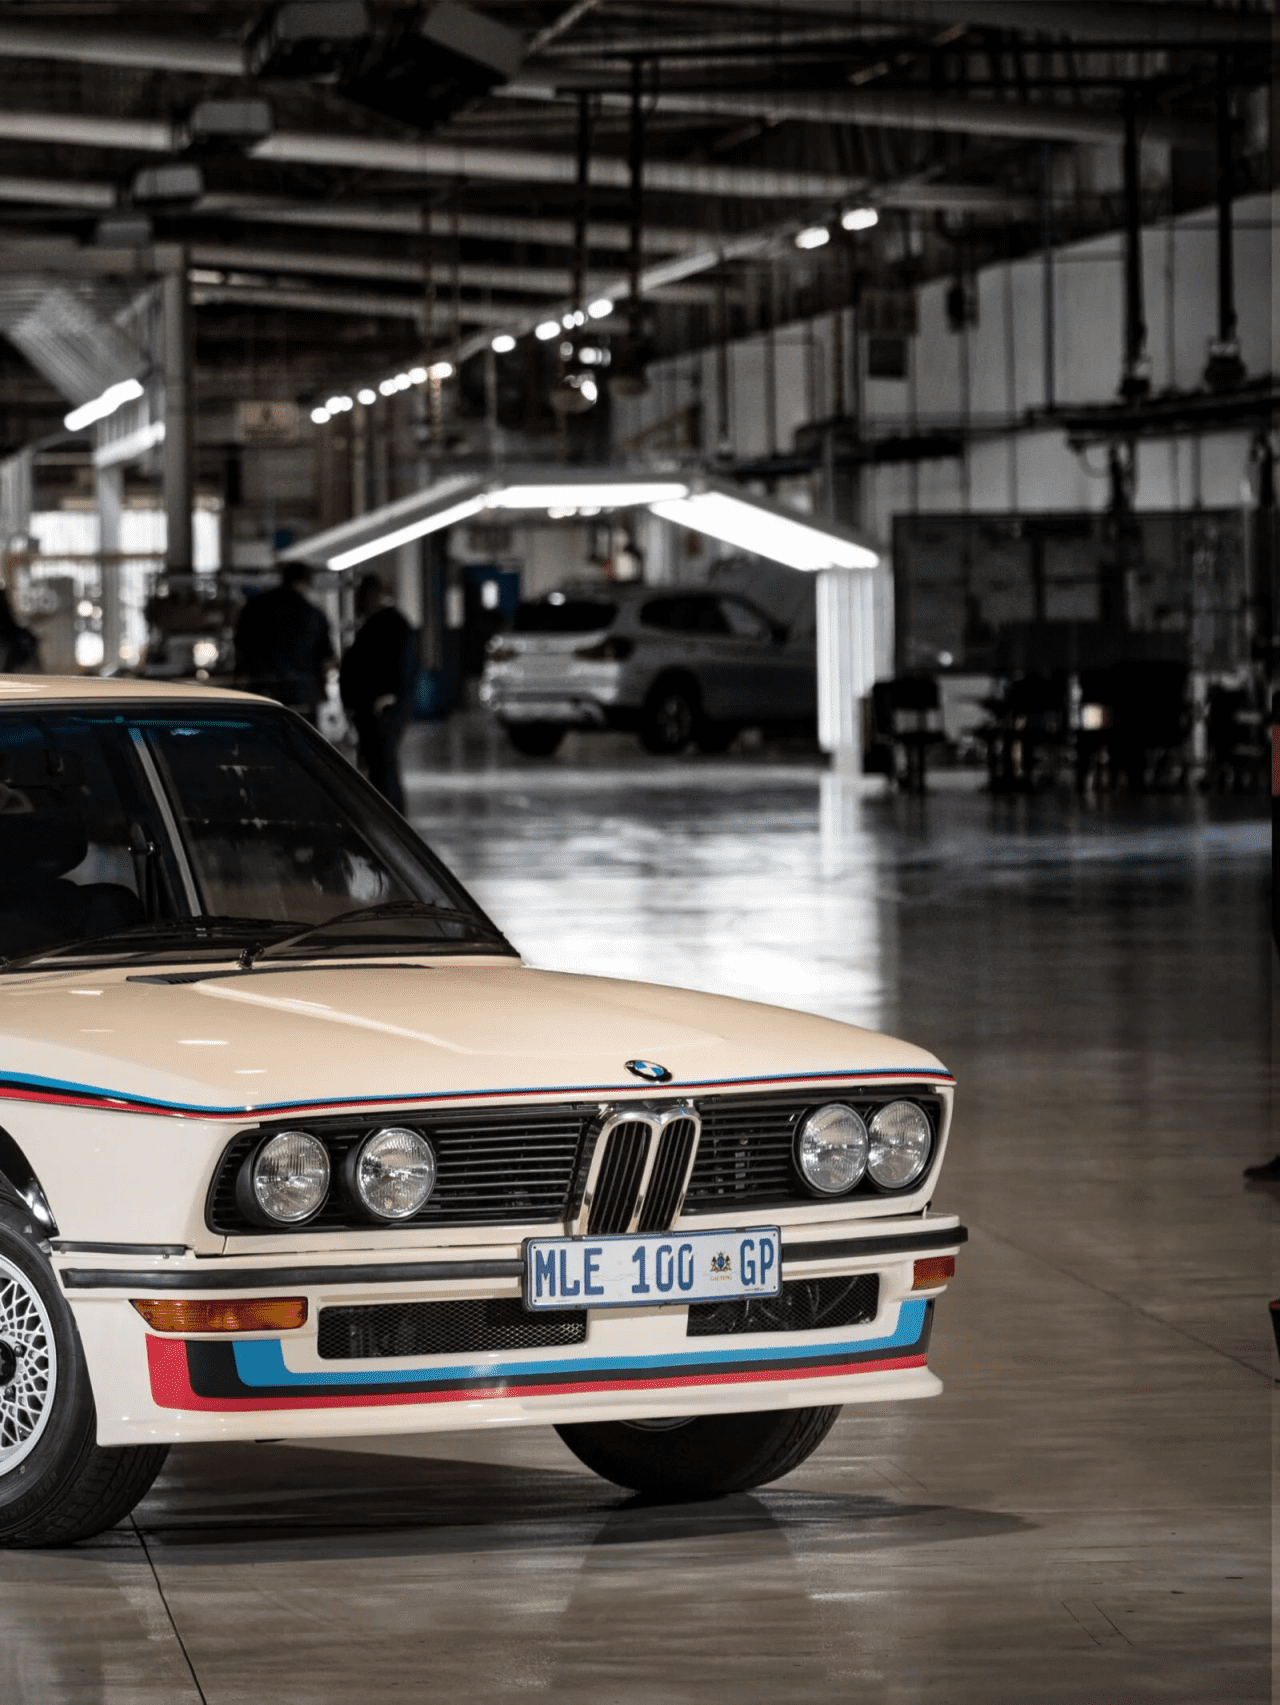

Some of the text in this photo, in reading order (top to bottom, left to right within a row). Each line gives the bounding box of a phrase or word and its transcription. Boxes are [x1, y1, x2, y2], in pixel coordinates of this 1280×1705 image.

[535, 1237, 775, 1297] MLE 100 GP
